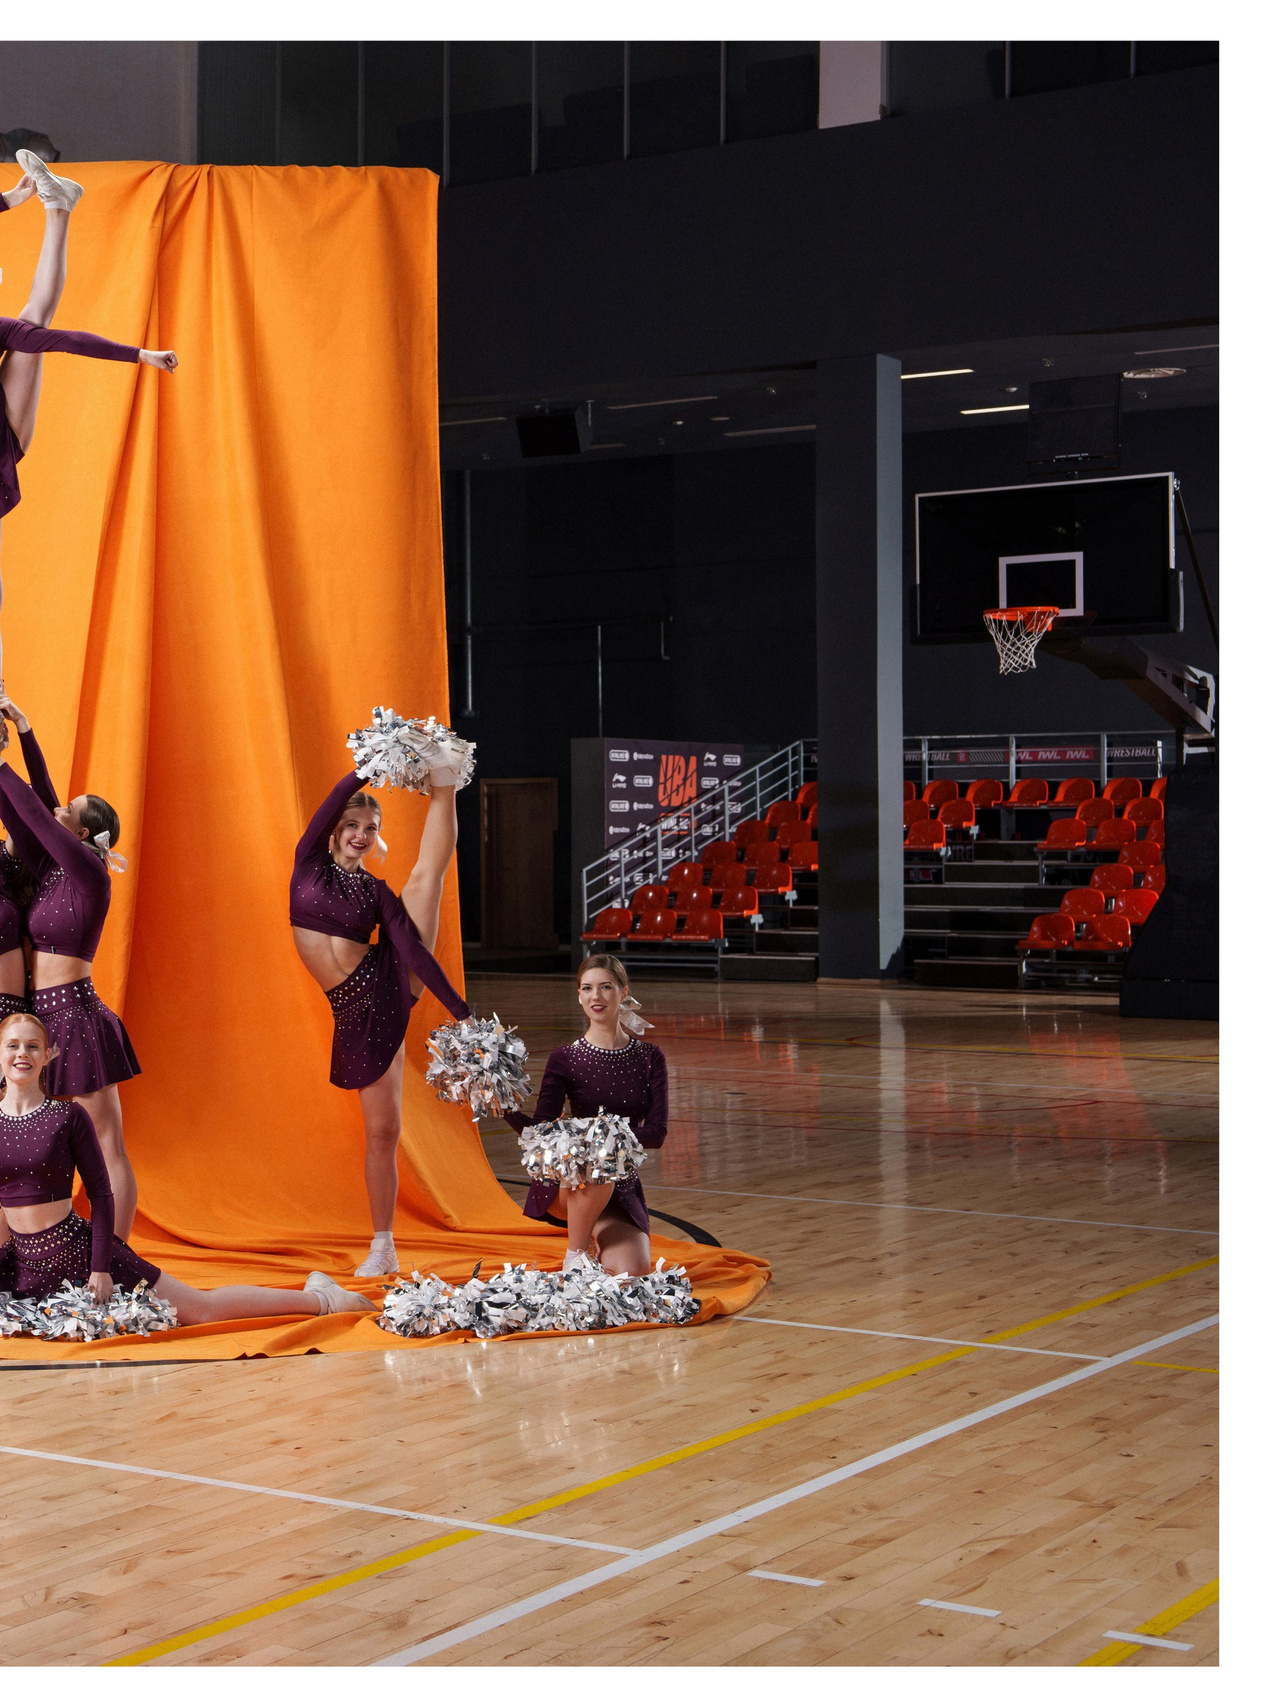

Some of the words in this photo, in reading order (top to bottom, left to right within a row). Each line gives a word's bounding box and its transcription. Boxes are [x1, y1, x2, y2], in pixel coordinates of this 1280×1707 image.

[1015, 750, 1033, 760] WL
[1037, 750, 1061, 760] IWL
[1065, 749, 1090, 759] IWL
[658, 754, 697, 806] UBA
